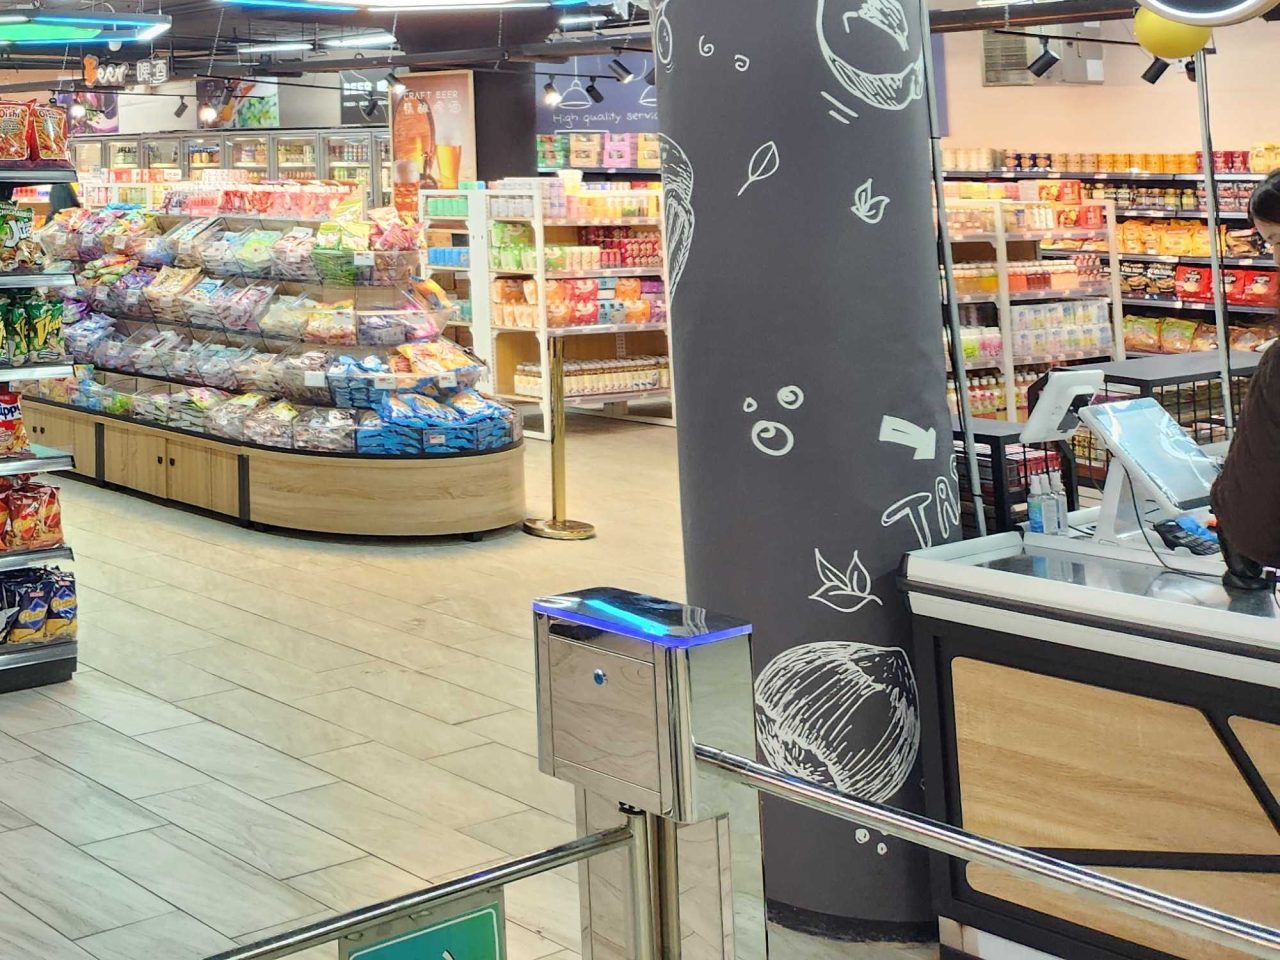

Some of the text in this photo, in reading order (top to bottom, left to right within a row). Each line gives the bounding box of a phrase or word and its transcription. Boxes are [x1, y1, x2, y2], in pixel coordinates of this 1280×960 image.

[83, 55, 128, 87] Beer
[552, 113, 579, 128] High
[583, 112, 621, 127] quality
